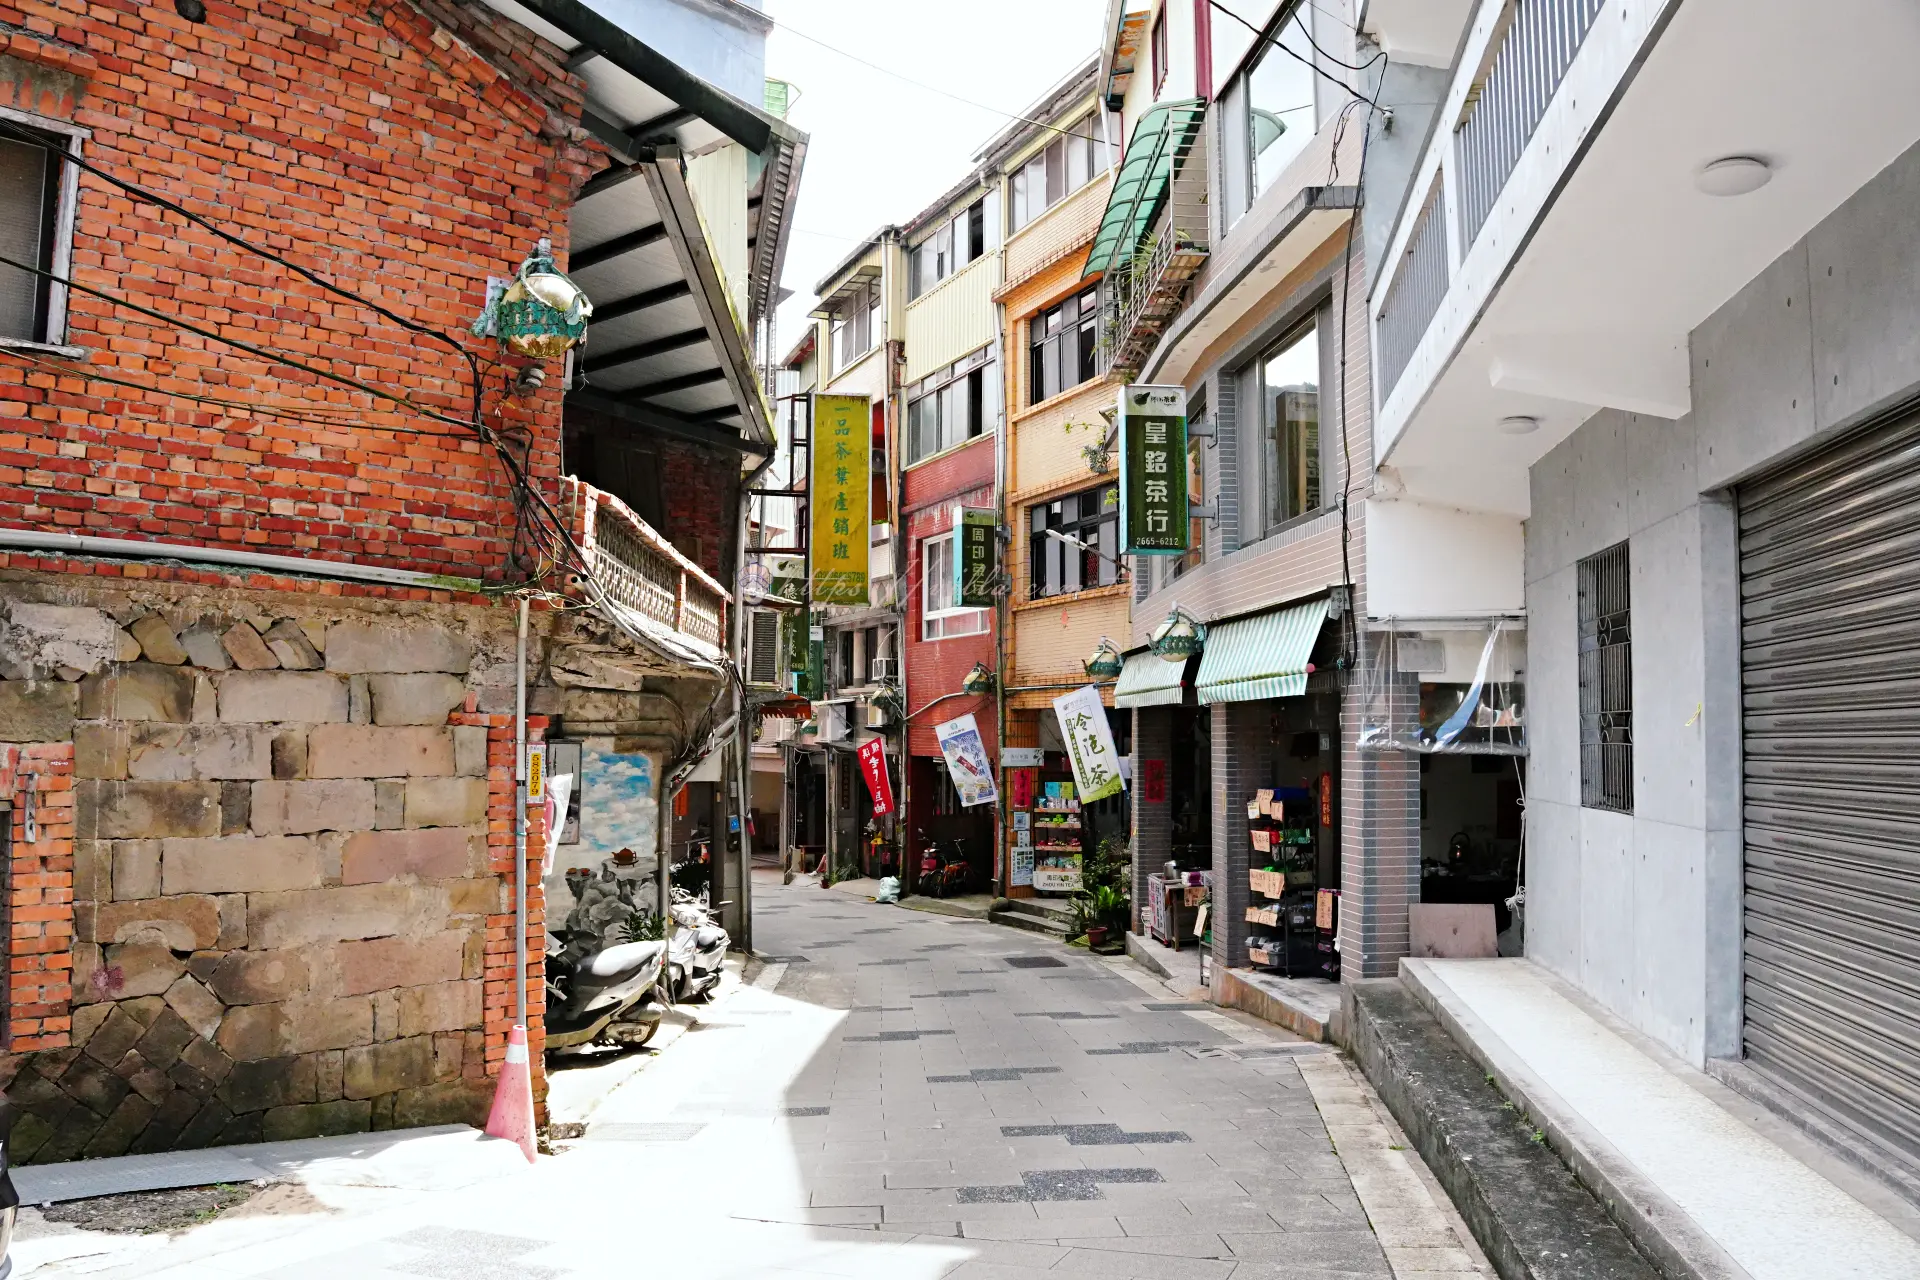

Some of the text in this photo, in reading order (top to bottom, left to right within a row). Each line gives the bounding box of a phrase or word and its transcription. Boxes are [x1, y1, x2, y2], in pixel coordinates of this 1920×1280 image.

[833, 407, 851, 559] 一品茶葉產銷班
[1145, 421, 1169, 532] 皇銘茶行
[1136, 537, 1179, 546] 2665-6212
[531, 754, 540, 795] 582079
[1072, 712, 1108, 785] 冷泡茶
